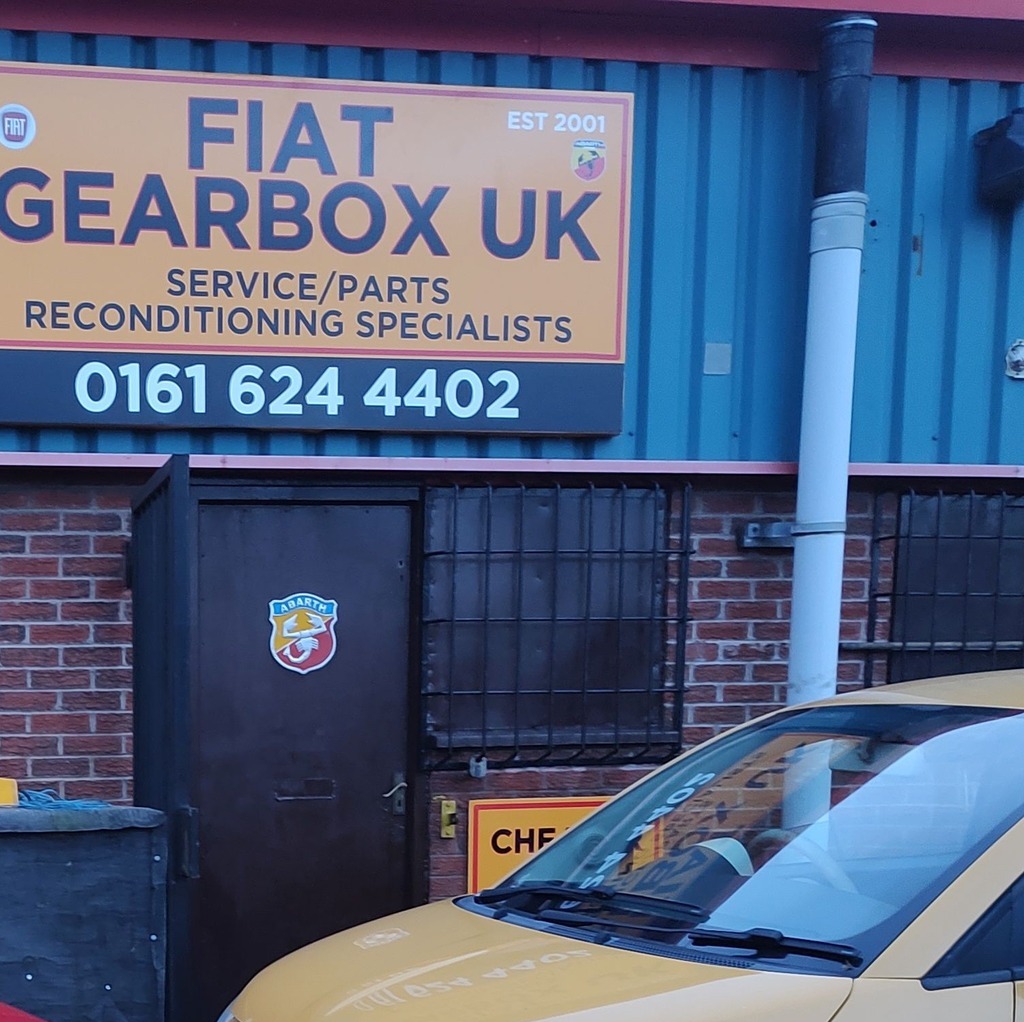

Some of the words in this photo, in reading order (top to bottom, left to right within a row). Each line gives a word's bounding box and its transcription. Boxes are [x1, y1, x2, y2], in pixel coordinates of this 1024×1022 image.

[4, 117, 26, 136] FIAT
[187, 97, 394, 177] FIAT
[508, 111, 548, 130] EST
[554, 113, 605, 133] 2001
[481, 187, 601, 262] UK
[167, 269, 450, 306] SERVICE/PARTS
[25, 301, 344, 339] RECONDITIONING
[356, 312, 573, 343] SPECIALISTS
[74, 361, 207, 414] 0161
[228, 365, 344, 416] 624
[363, 368, 520, 419] 4402
[280, 597, 328, 613] ABARTH
[491, 826, 573, 855] CHE
